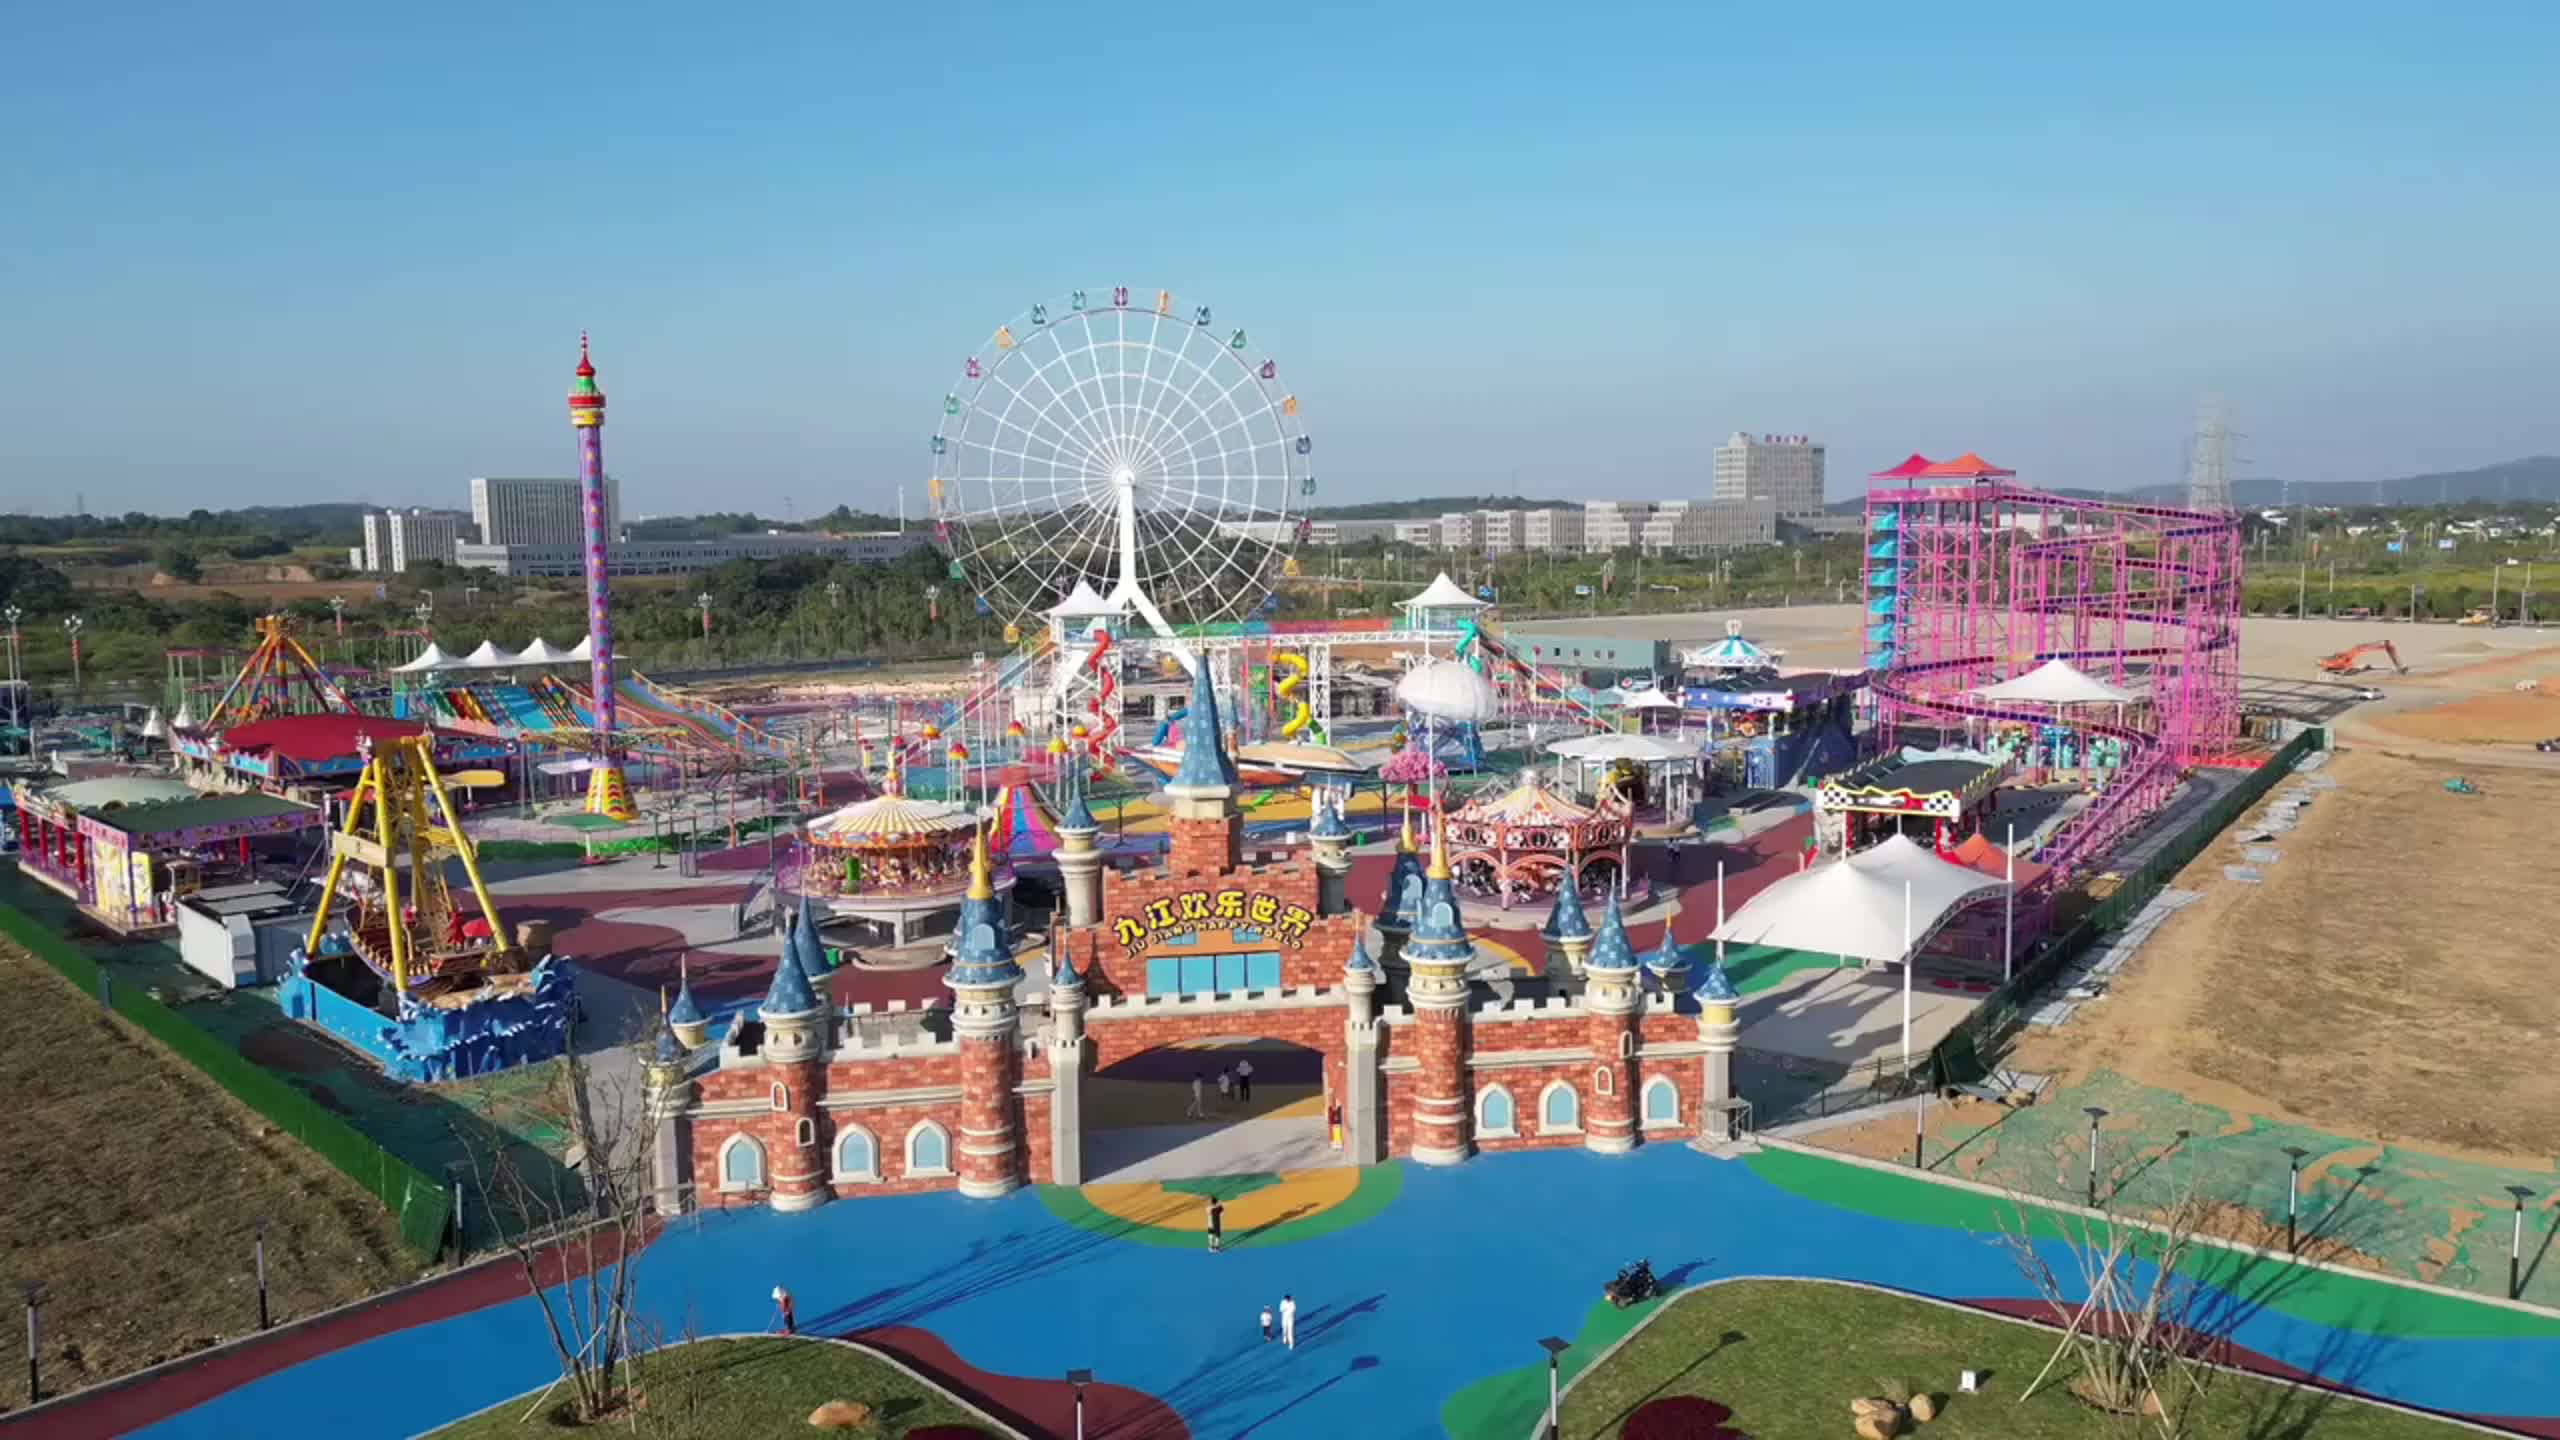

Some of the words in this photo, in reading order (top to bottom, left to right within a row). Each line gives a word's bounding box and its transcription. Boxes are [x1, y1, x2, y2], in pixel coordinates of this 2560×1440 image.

[1115, 890, 1313, 945] 九江欢乐世界
[1126, 940, 1148, 959] JIU
[1151, 923, 1194, 945] JIANG
[1198, 920, 1249, 932] HAPPY
[1254, 926, 1304, 950] WORLD
